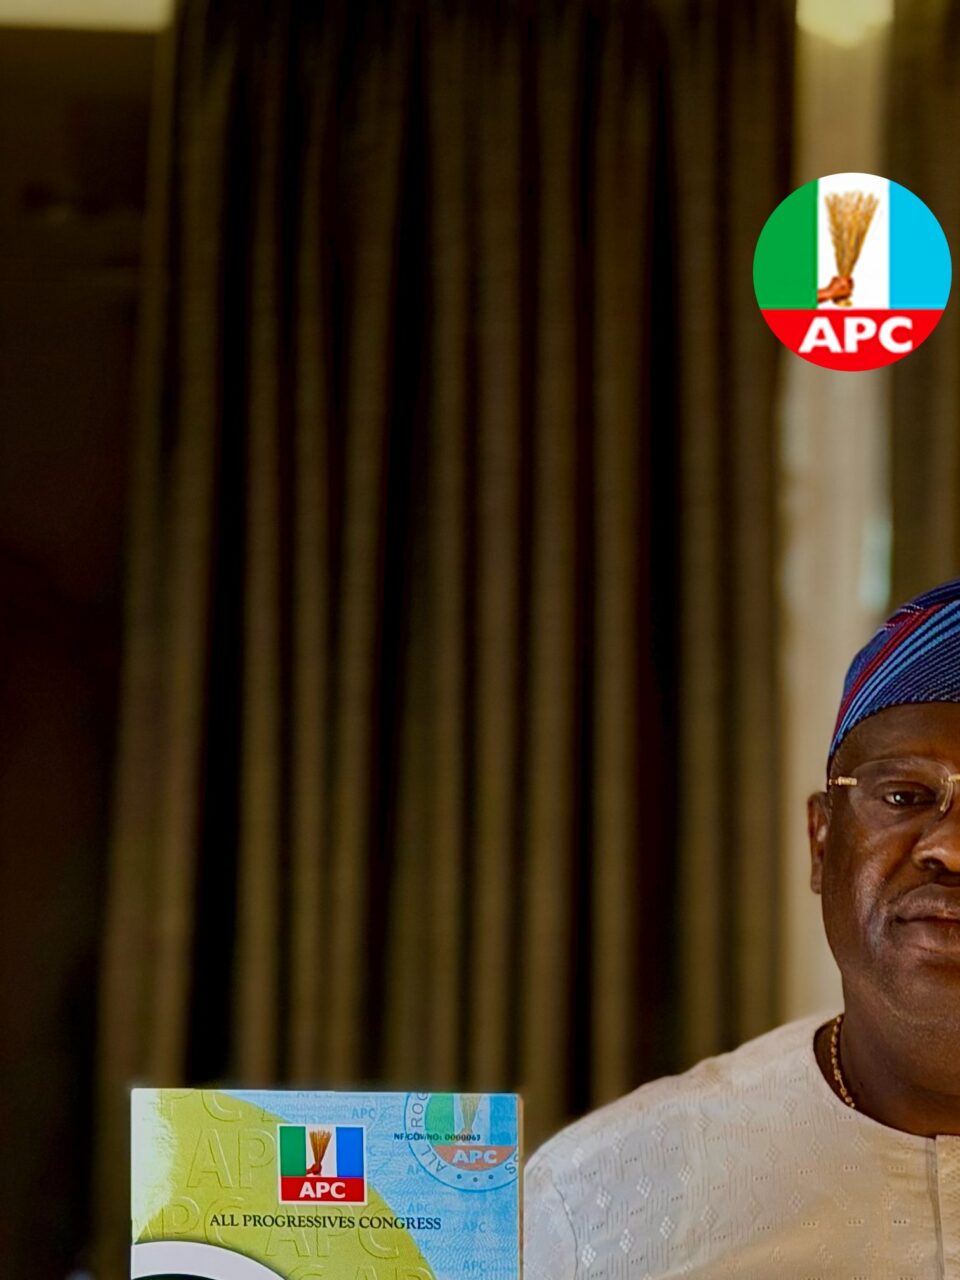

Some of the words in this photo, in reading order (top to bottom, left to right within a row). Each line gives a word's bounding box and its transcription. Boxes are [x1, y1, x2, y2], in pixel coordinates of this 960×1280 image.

[452, 1149, 497, 1164] APC
[298, 1181, 346, 1199] APC
[210, 1214, 239, 1227] ALL
[243, 1214, 356, 1229] PROGRESSIVES
[358, 1216, 441, 1230] CONGRESS
